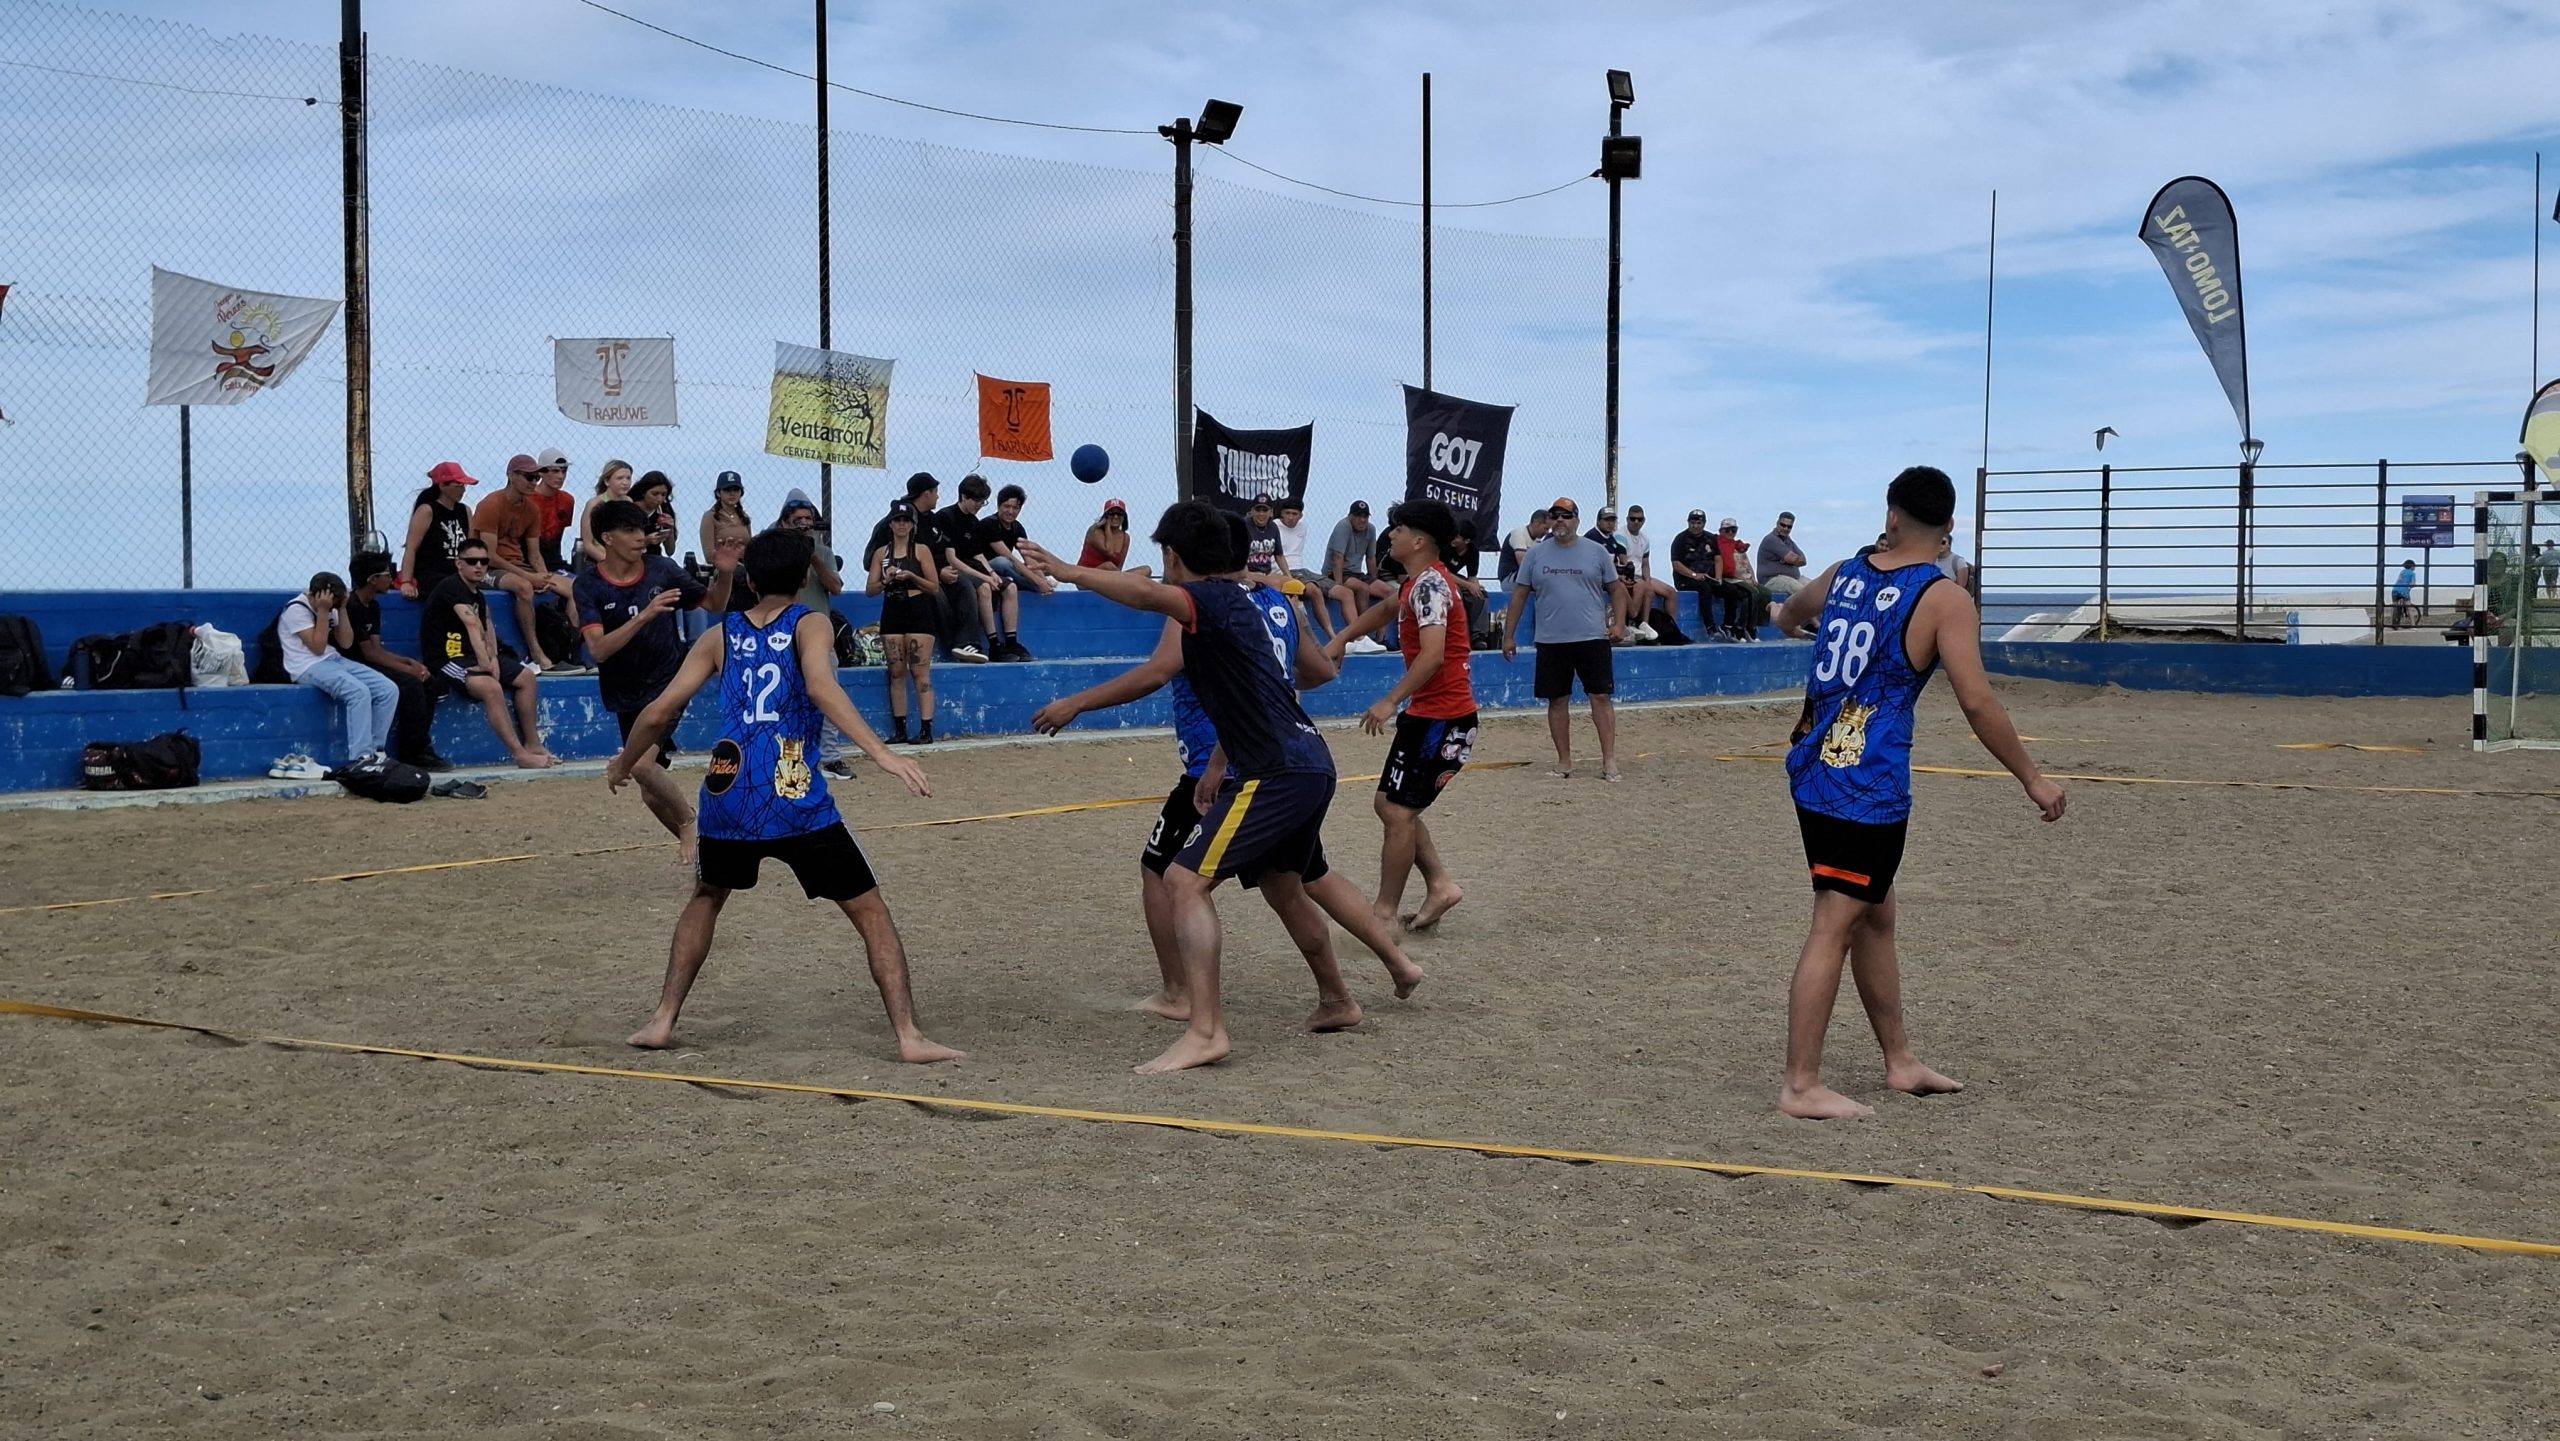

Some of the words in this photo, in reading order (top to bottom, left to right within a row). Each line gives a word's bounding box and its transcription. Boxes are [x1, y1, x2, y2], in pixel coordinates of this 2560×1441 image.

[582, 401, 649, 421] TRARUWE
[779, 415, 865, 446] Ventarrón
[782, 445, 821, 461] CERVEZA
[825, 453, 873, 466] ARTESANAL
[1429, 431, 1484, 480] GO7
[1426, 483, 1441, 501] GO
[1444, 489, 1479, 512] SEVEN
[1541, 565, 1584, 576] Deportes
[1816, 618, 1876, 687] 38
